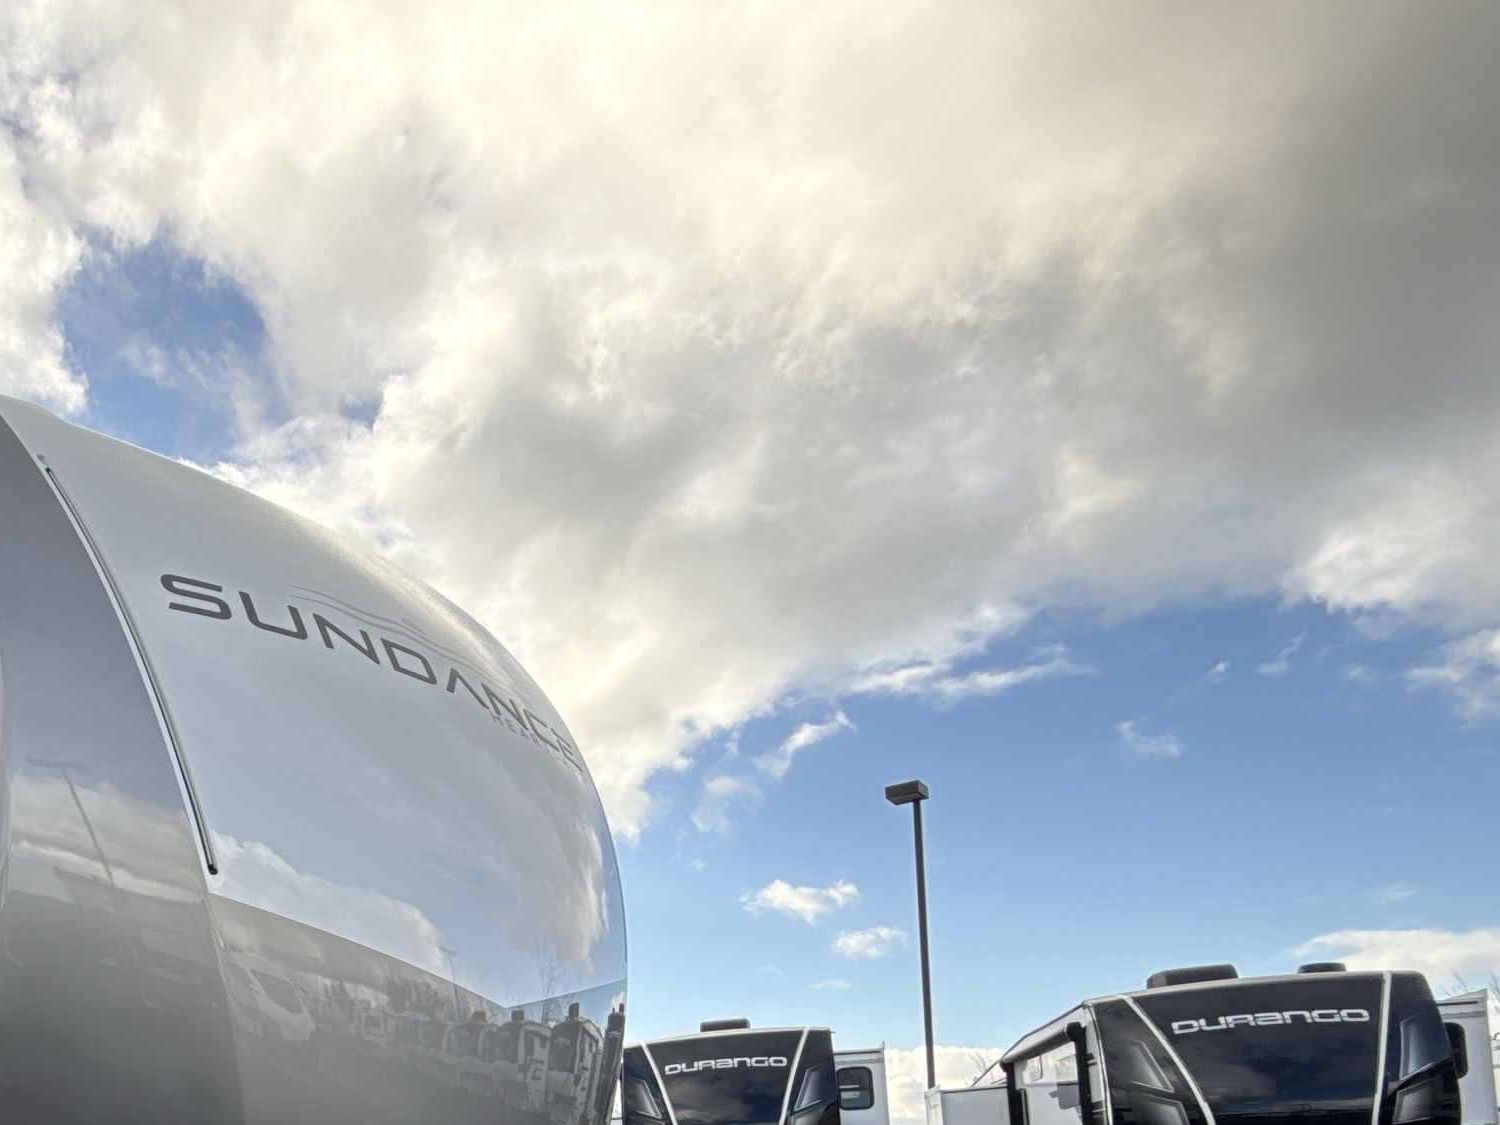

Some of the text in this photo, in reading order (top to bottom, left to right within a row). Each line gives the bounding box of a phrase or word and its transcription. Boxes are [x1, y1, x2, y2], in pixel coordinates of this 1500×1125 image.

[160, 573, 583, 772] SUNDANCE
[1171, 1008, 1370, 1034] DURANGO
[664, 1056, 787, 1075] DURANGO
